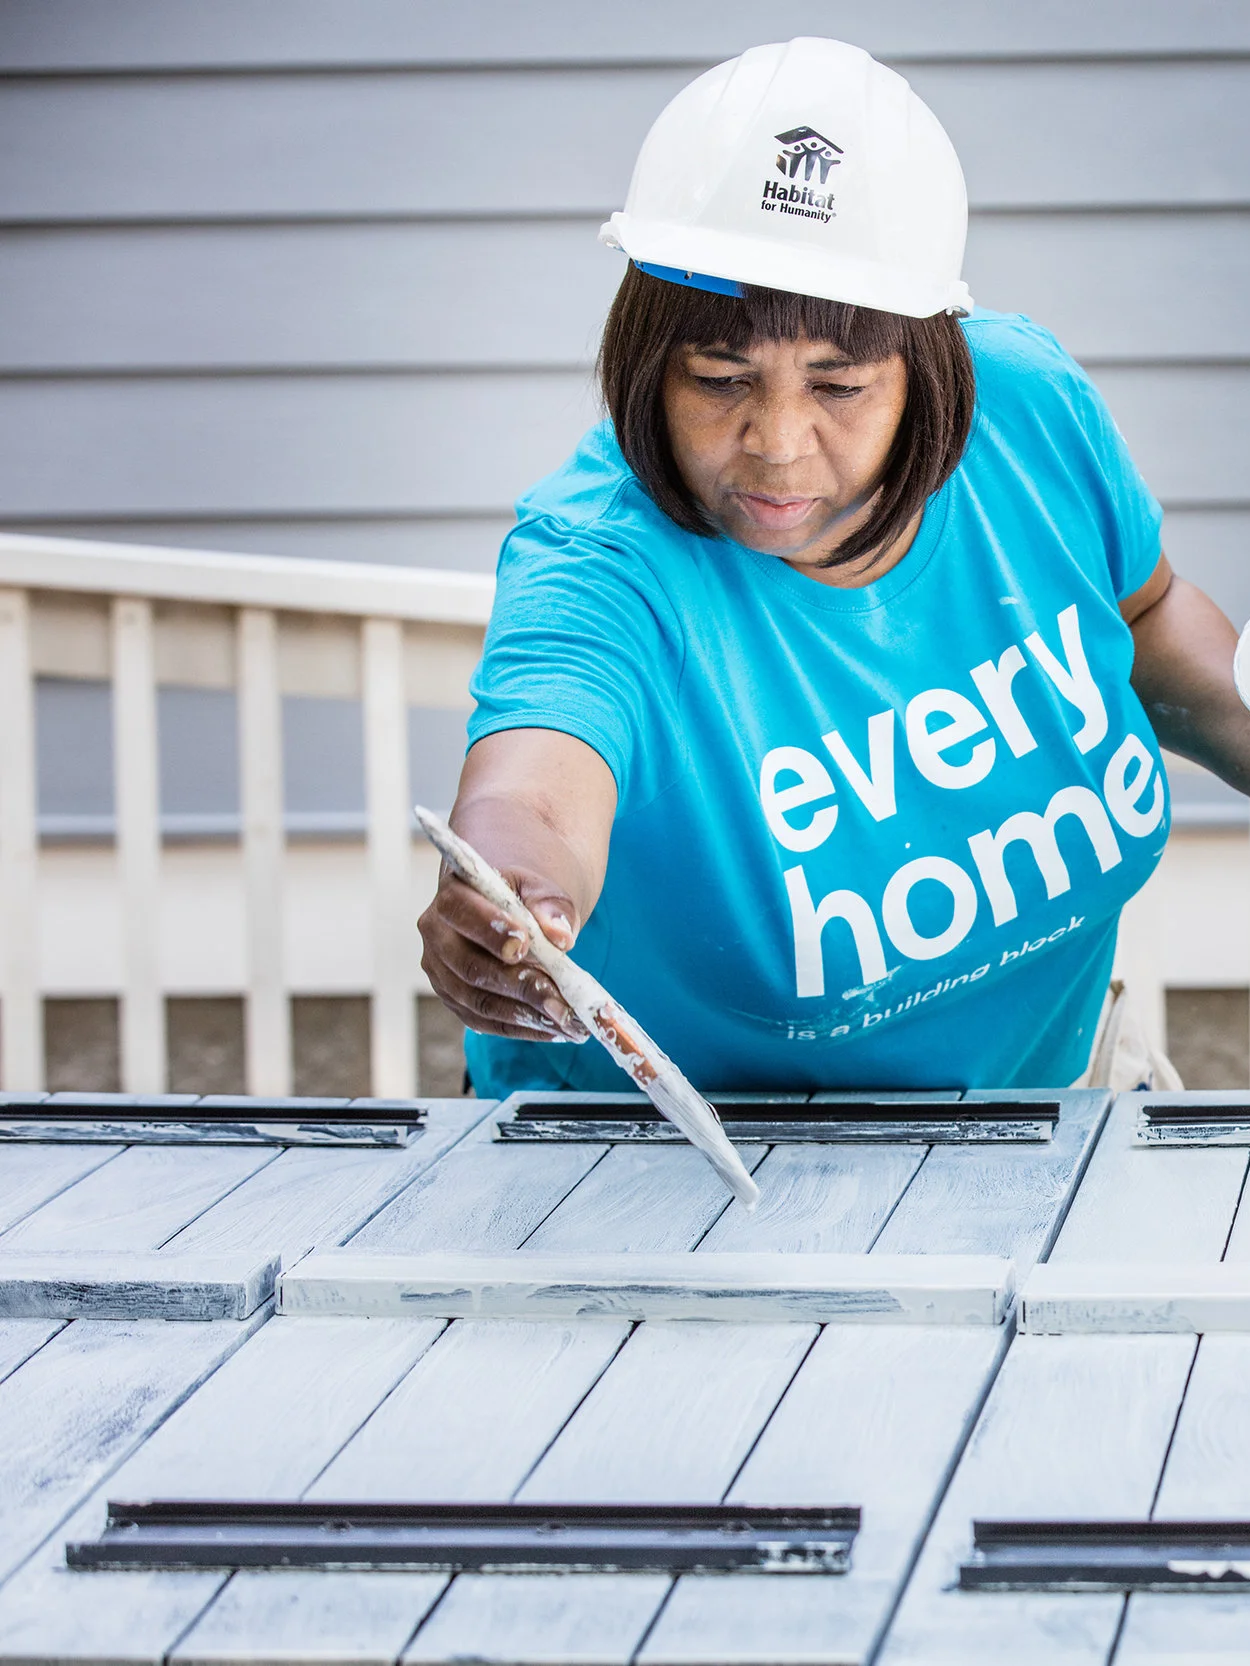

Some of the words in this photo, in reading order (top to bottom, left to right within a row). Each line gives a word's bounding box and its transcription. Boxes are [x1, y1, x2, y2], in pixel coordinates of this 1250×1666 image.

[761, 200, 777, 211] for
[780, 202, 832, 224] Humanity
[763, 180, 835, 211] Habitat
[759, 603, 1109, 852] every
[784, 733, 1165, 998] home
[787, 1026, 816, 1041] is
[830, 1024, 850, 1037] a
[862, 963, 991, 1029] building
[1000, 916, 1086, 967] block
